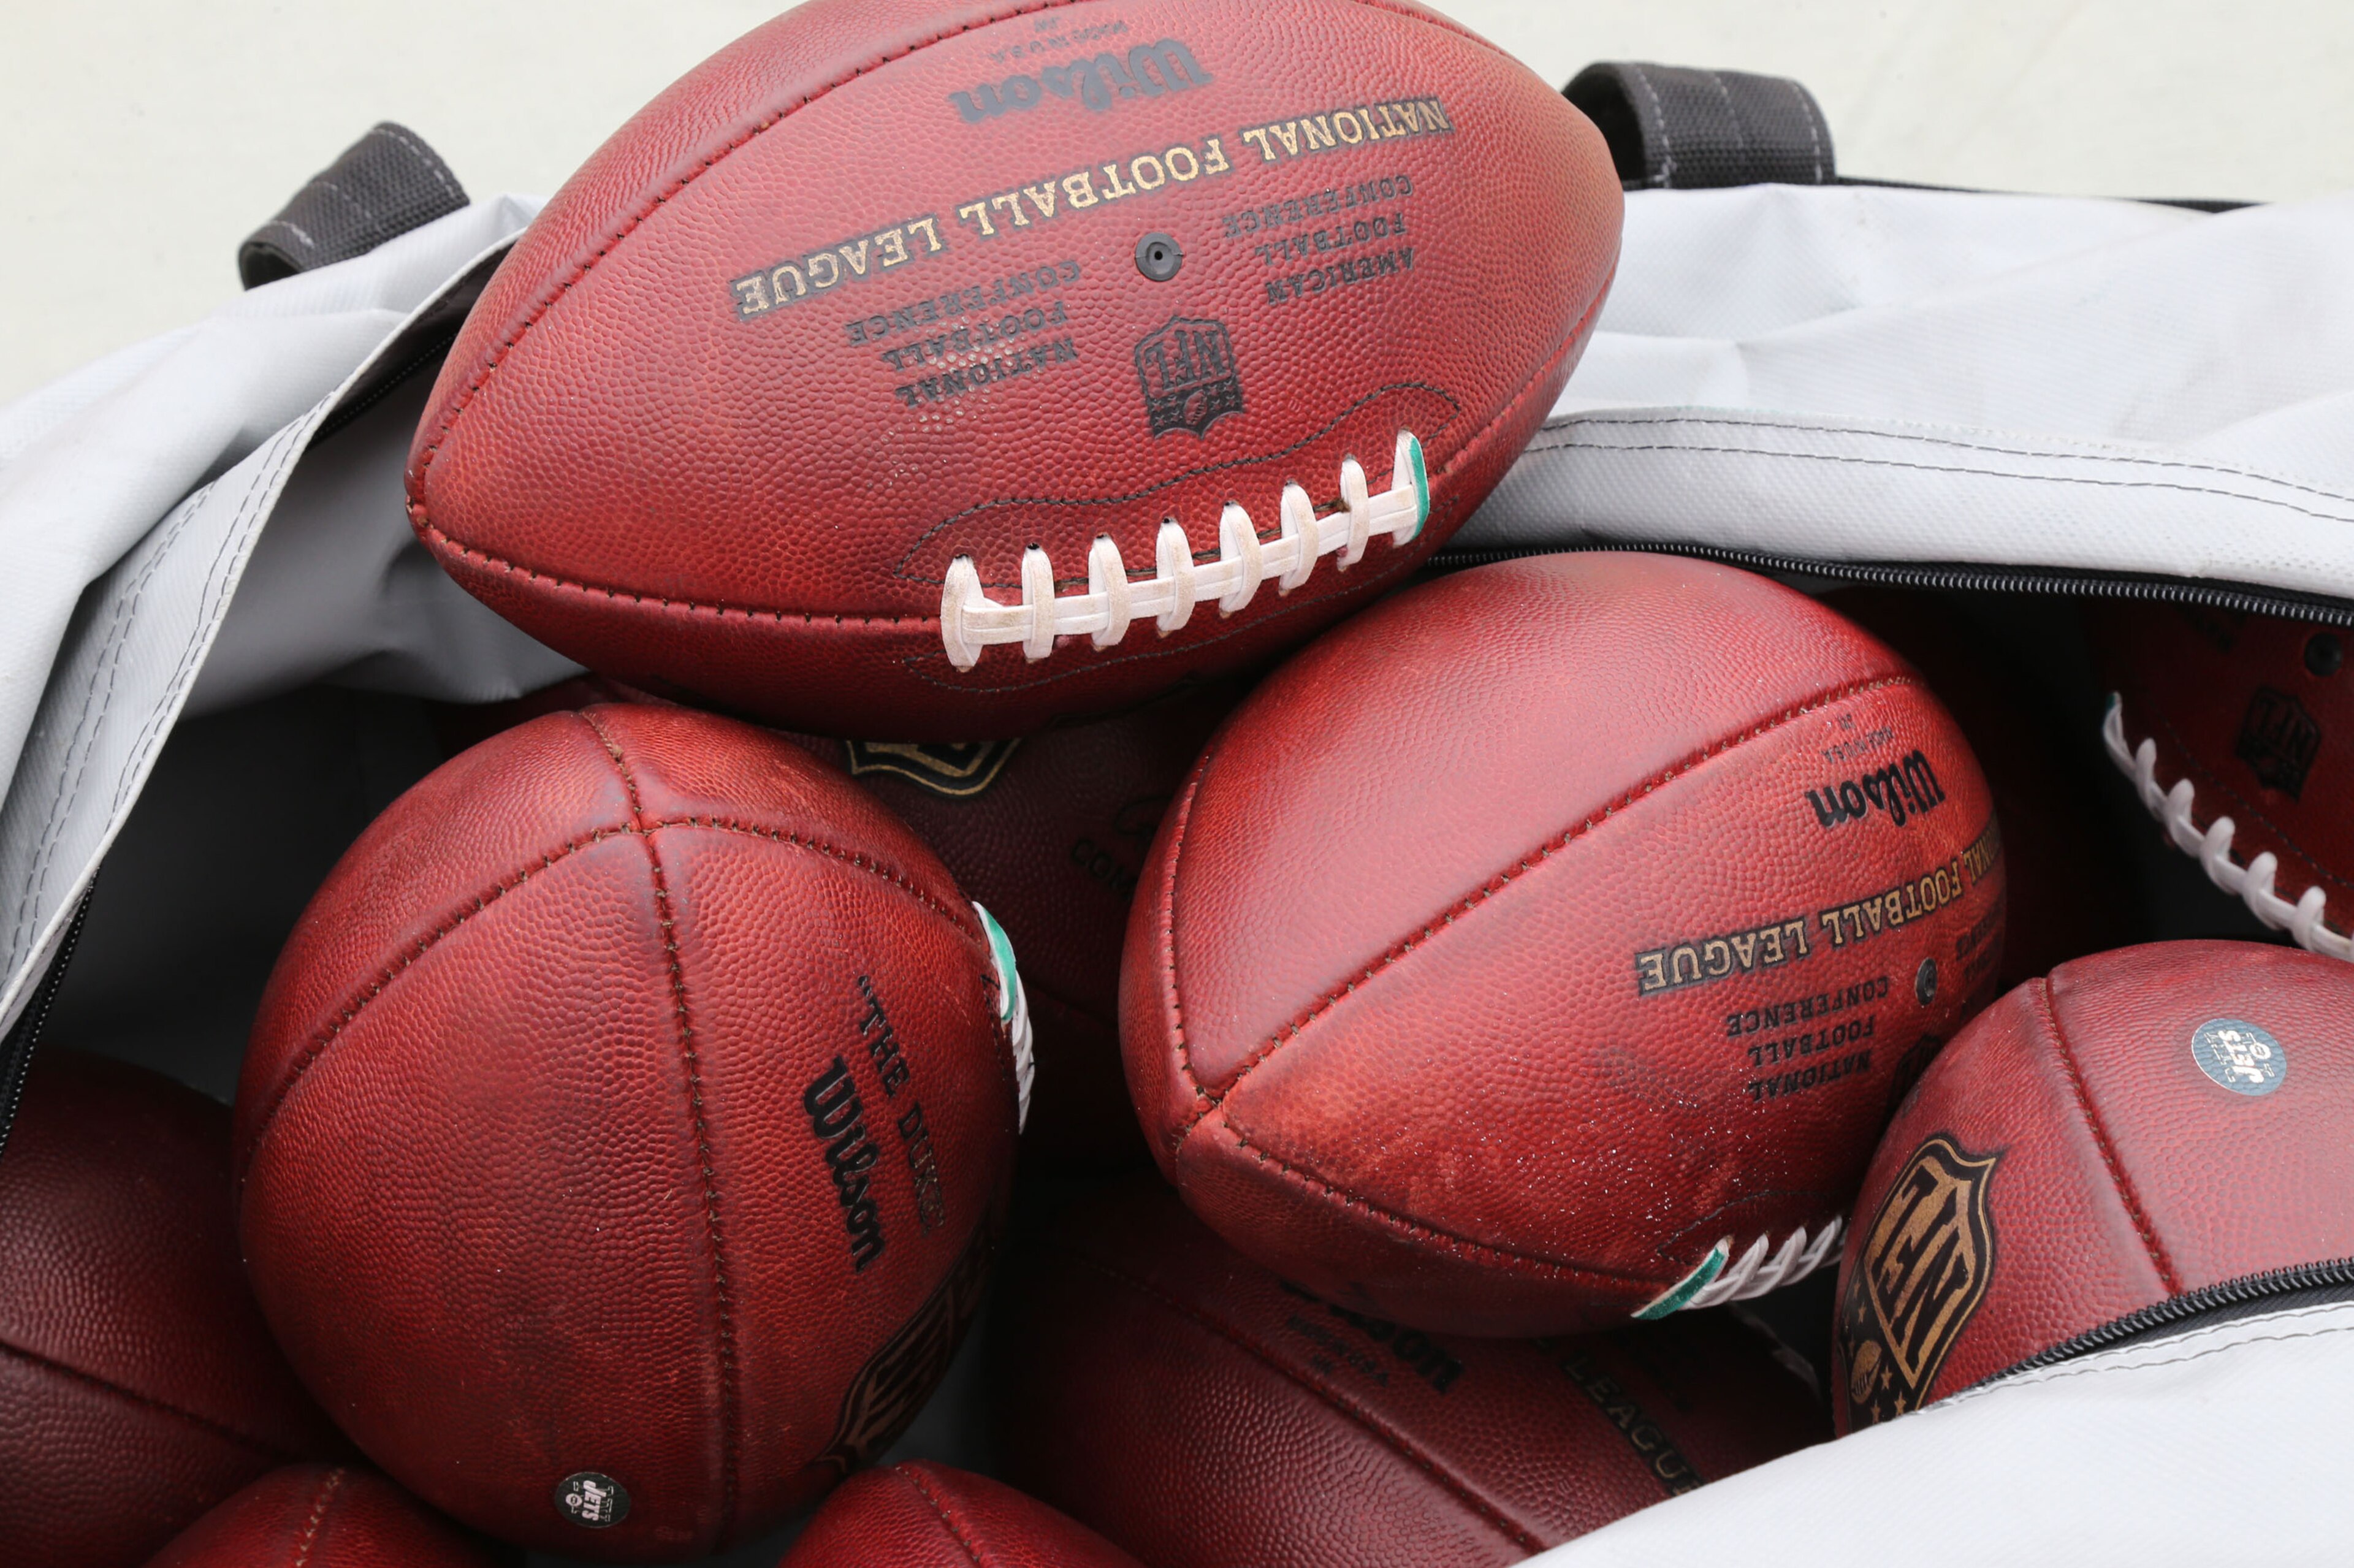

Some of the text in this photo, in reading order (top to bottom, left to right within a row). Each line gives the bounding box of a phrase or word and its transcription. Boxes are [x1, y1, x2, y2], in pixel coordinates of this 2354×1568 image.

[948, 37, 1213, 123] Wilson
[730, 97, 1453, 319] NATIONAL FOOTBALL LEAGUE
[1223, 175, 1414, 238] CONFERENCE
[1255, 212, 1406, 265] FOOTBALL
[845, 260, 1081, 346] CONFERENCE
[1265, 247, 1414, 305] AMERICAN
[882, 300, 1068, 371] FOOTBALL
[1144, 330, 1230, 391] NFL
[895, 337, 1078, 409] NATIONAL
[1805, 749, 1946, 826] Wilson
[1821, 860, 1963, 949] FOOTBALL
[1636, 916, 1809, 995] LEAGUE
[1727, 976, 1889, 1037] CONFERENCE
[1748, 1014, 1875, 1068] FOOTBALL
[2217, 1030, 2264, 1083] JETS
[1747, 1049, 1873, 1102] NATIONAL
[803, 1055, 885, 1273] Wilson
[581, 1480, 607, 1521] JETS
